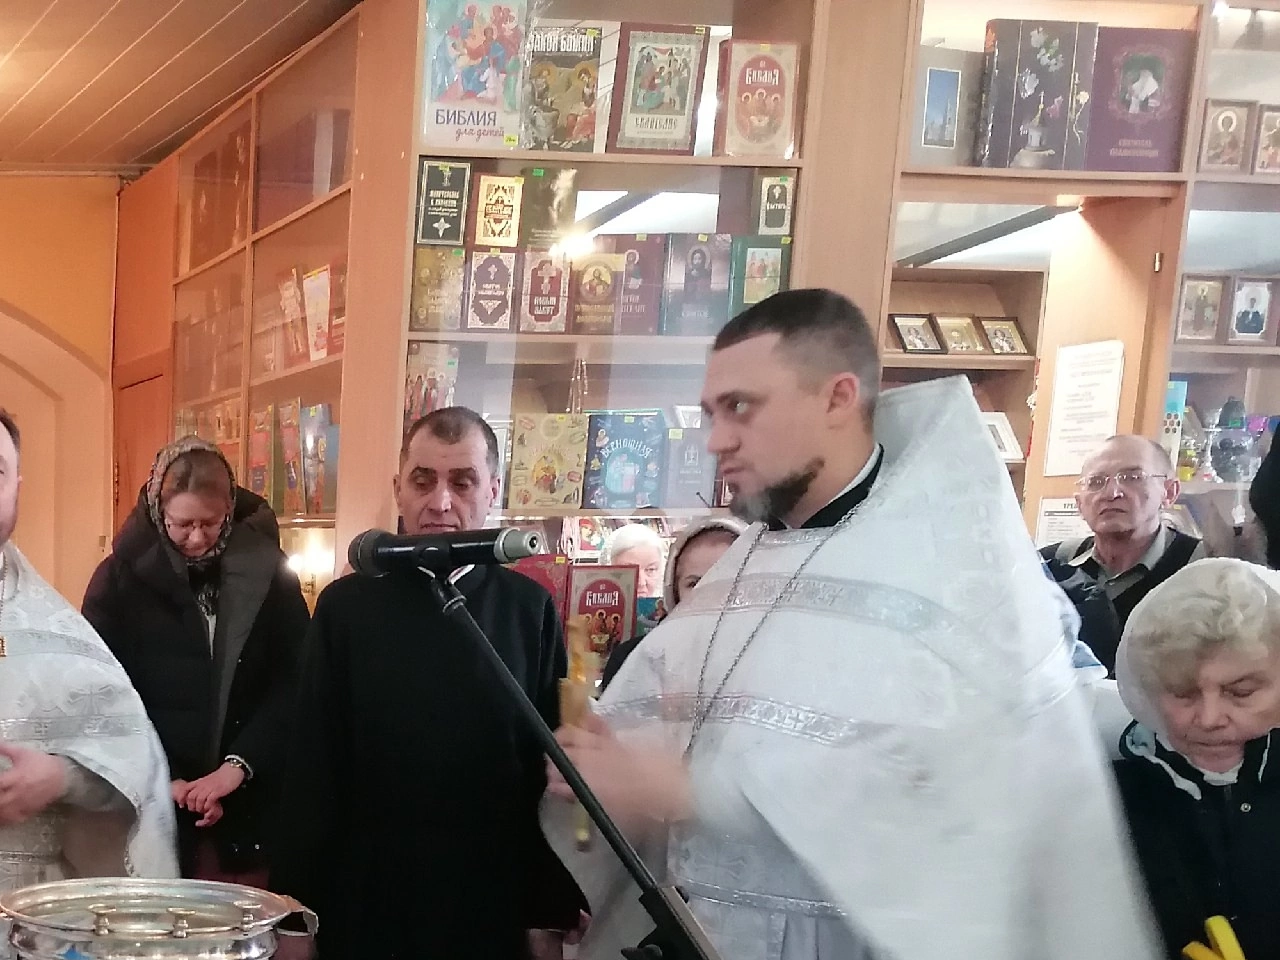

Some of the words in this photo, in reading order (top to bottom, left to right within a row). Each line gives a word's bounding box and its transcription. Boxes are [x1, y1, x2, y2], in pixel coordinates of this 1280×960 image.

[435, 108, 497, 127] БИБЛИЯ
[455, 127, 476, 142] для
[476, 127, 505, 143] детей
